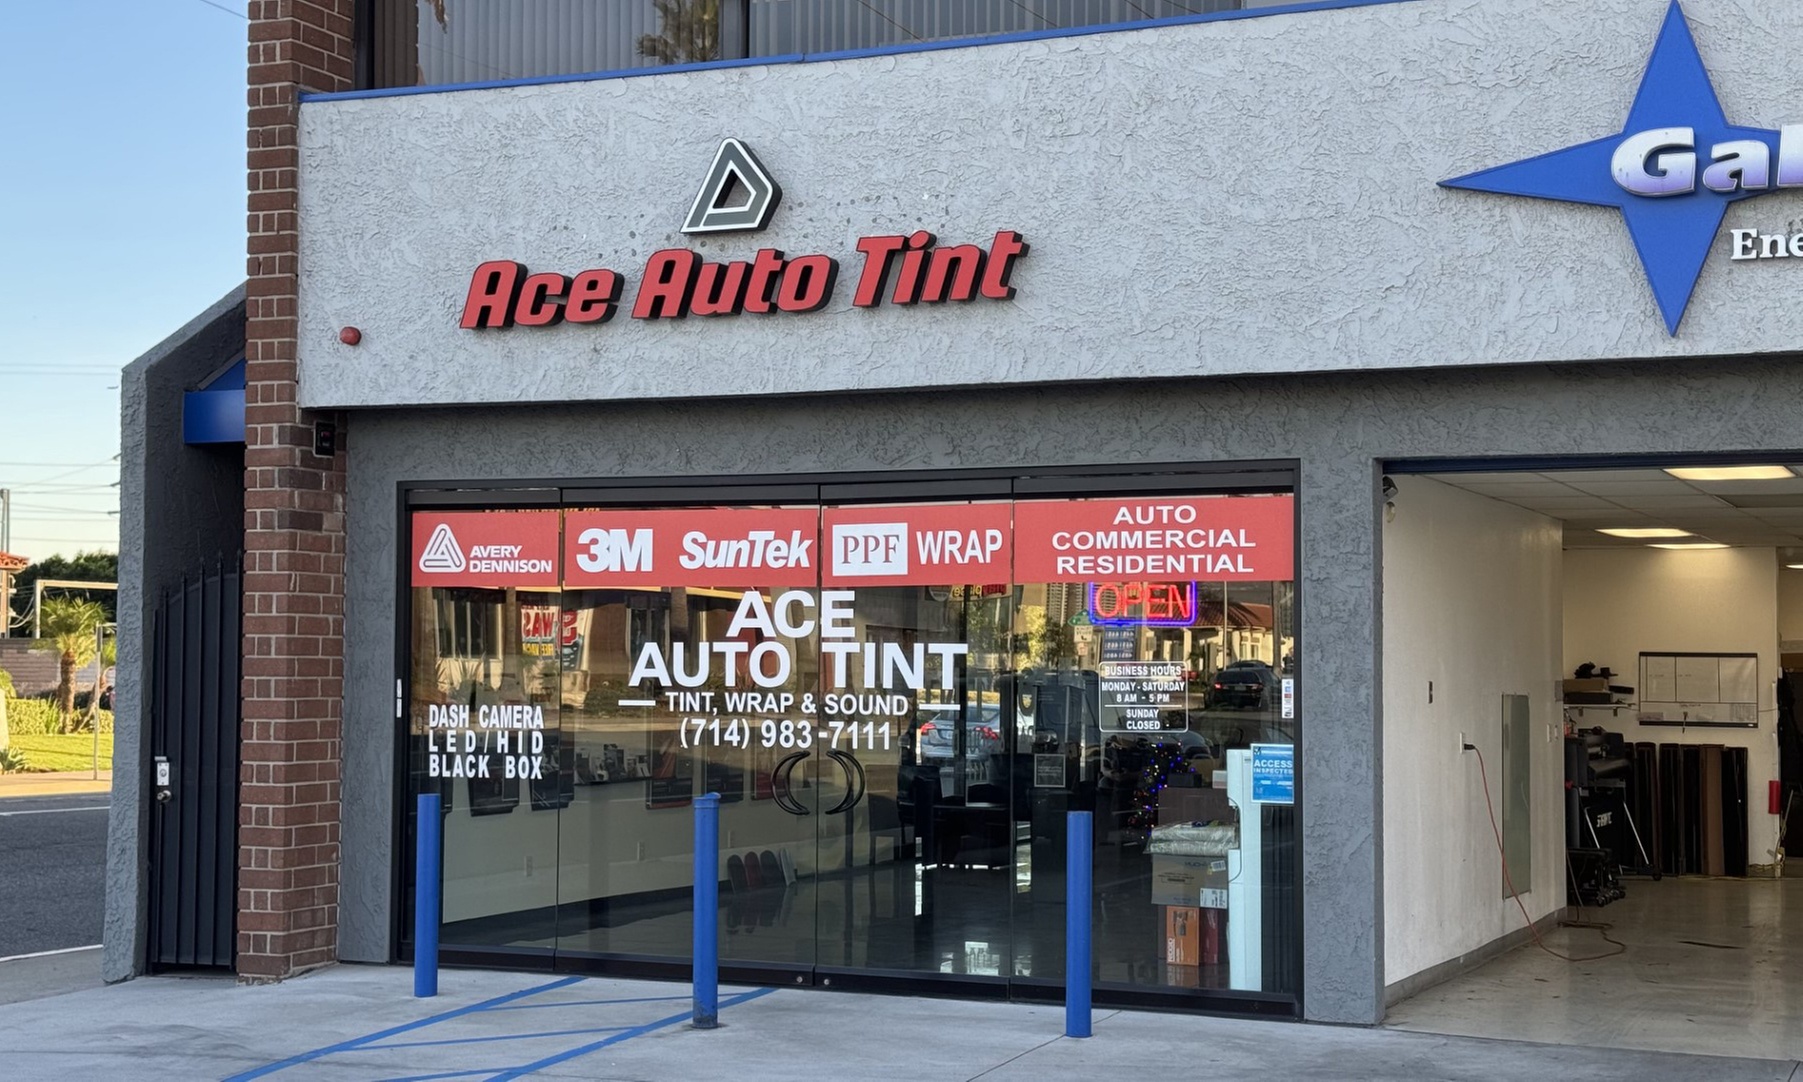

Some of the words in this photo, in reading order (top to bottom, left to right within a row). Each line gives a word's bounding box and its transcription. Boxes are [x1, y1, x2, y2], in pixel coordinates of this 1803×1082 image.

[460, 259, 624, 331] Ace
[632, 248, 838, 320] Auto
[853, 230, 1028, 307] Tint
[1113, 505, 1197, 525] AUTO
[470, 545, 523, 558] AVERY
[576, 528, 654, 573] 3M
[679, 530, 814, 570] SunTek
[841, 534, 900, 565] PPF
[915, 529, 1003, 565] WRAP
[1052, 529, 1257, 551] COMMERCIAL
[469, 559, 553, 574] DENNISON
[1056, 553, 1254, 575] RESIDENTIAL
[1095, 583, 1191, 618] OPEN
[726, 591, 856, 638] ACE
[628, 642, 791, 688] AUTO
[821, 642, 969, 690] TINT
[1105, 666, 1148, 675] BUSINESS
[1151, 665, 1182, 675] HOURS
[1102, 681, 1136, 691] MONDAY
[1142, 681, 1185, 691] SATURDAY
[665, 692, 718, 716] TINT,
[725, 692, 794, 713] WRAP
[801, 693, 817, 714] &
[825, 694, 909, 716] SOUND
[1116, 693, 1122, 703] 8
[1124, 693, 1138, 703] AM
[1149, 694, 1155, 703] 5
[1157, 693, 1170, 703] PM
[429, 704, 469, 729] DASH
[478, 705, 545, 729] CAMERA
[1126, 709, 1159, 718] SUNDAY
[680, 718, 750, 749] (714)
[761, 720, 890, 750] 983-7111
[1126, 721, 1160, 730] CLOSED
[429, 754, 490, 778] BLACK
[505, 755, 543, 780] BOX
[1253, 760, 1294, 768] ACCESS
